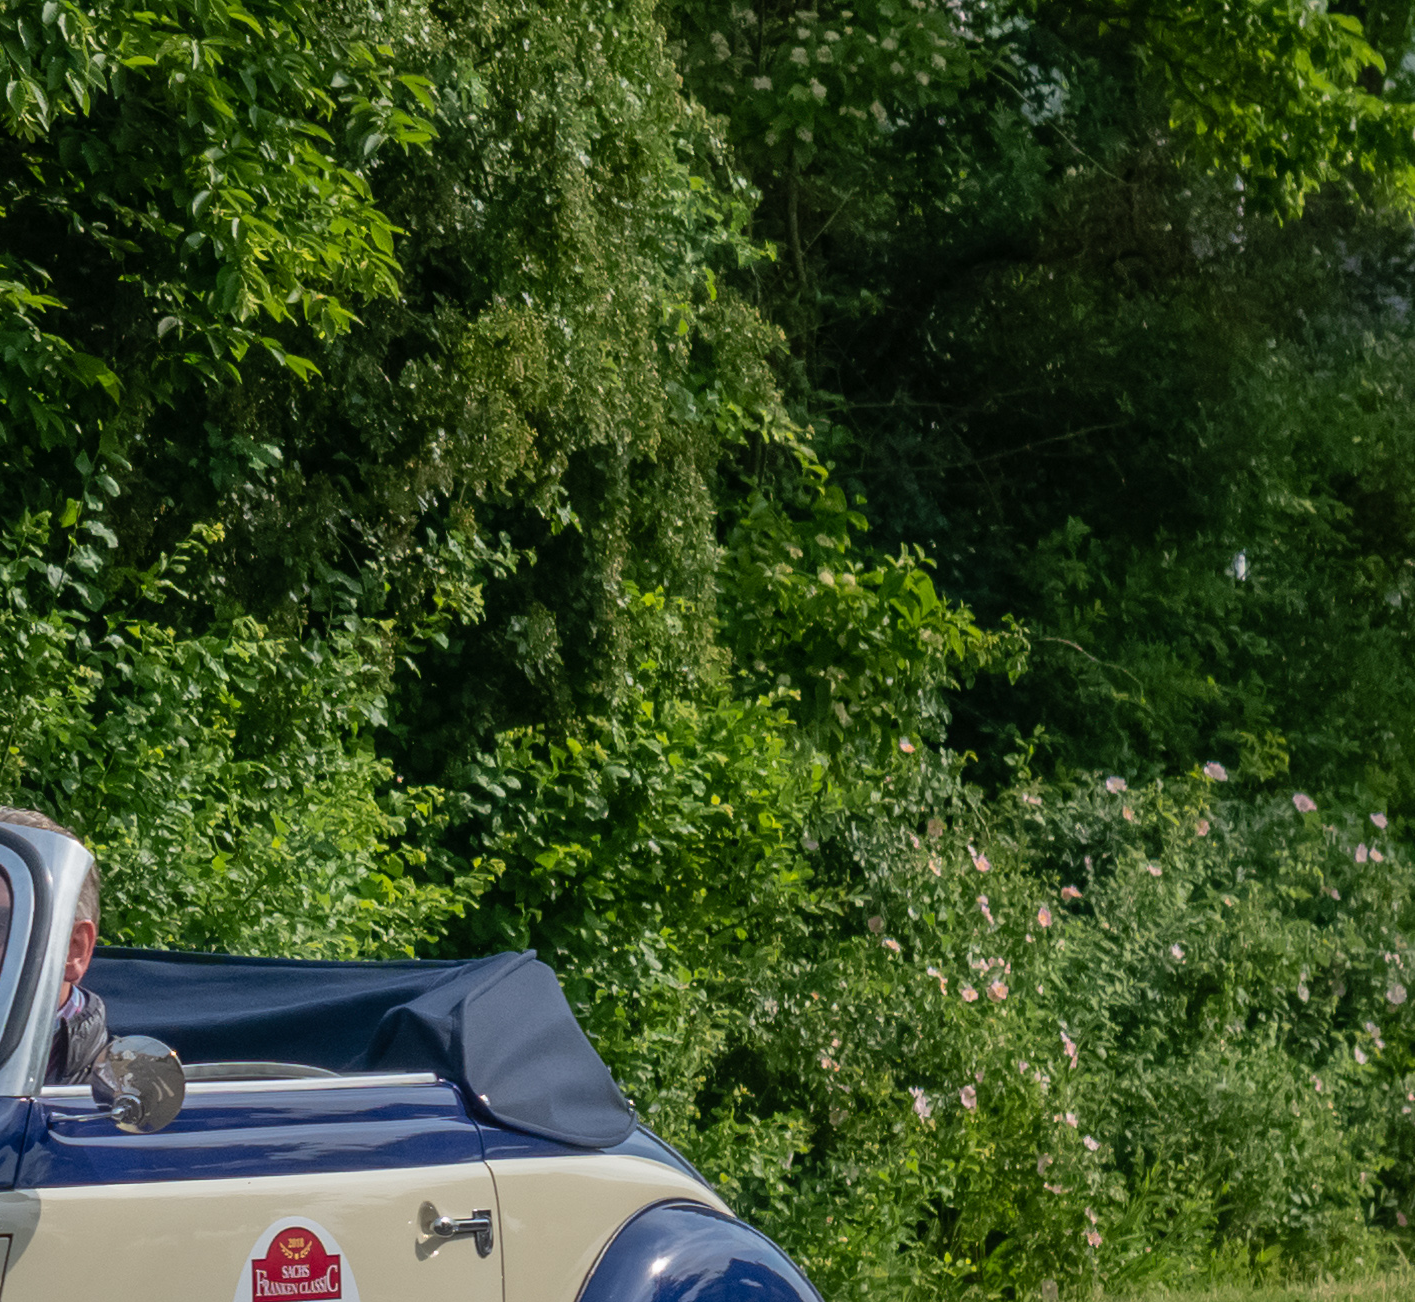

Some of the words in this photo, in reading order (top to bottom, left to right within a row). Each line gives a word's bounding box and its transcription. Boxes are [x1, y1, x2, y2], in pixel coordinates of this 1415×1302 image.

[255, 1269, 298, 1297] FRANKEN
[299, 1264, 339, 1294] CLASSIC
[281, 1264, 310, 1279] SACHS
